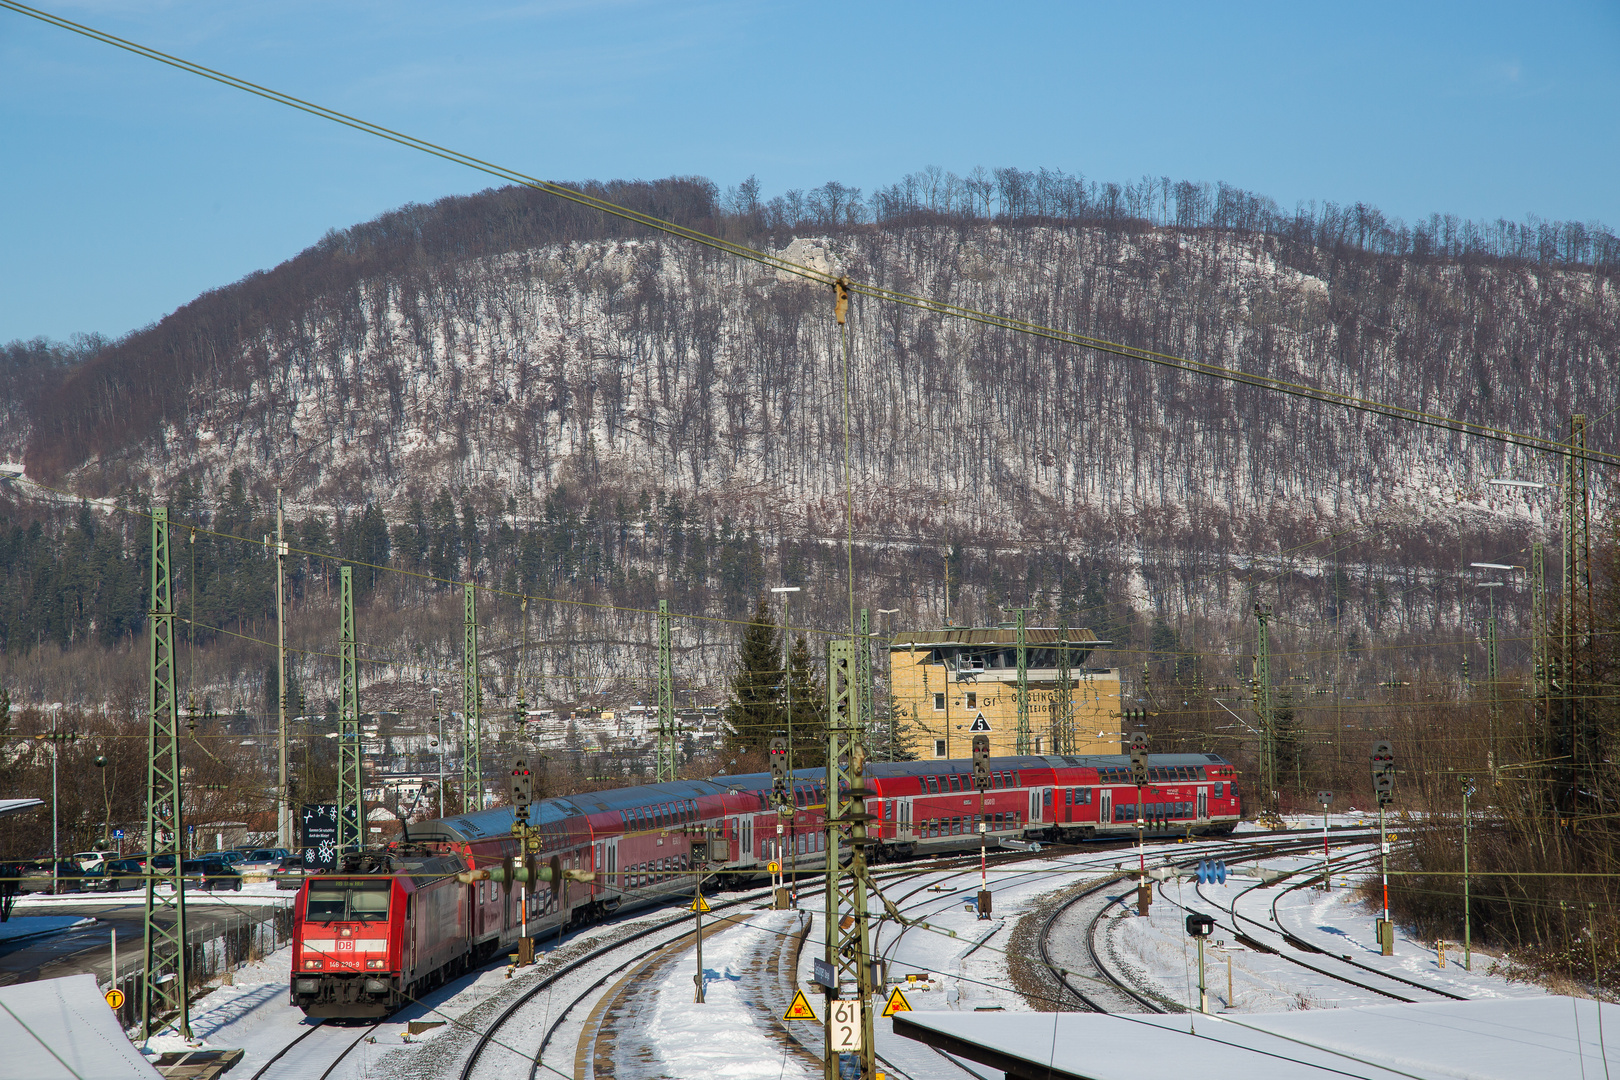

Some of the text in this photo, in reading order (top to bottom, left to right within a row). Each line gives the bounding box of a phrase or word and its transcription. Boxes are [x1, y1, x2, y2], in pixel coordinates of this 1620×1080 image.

[977, 719, 984, 731] 5
[338, 941, 352, 950] DB
[835, 1003, 854, 1023] 61
[840, 1026, 852, 1046] 2
